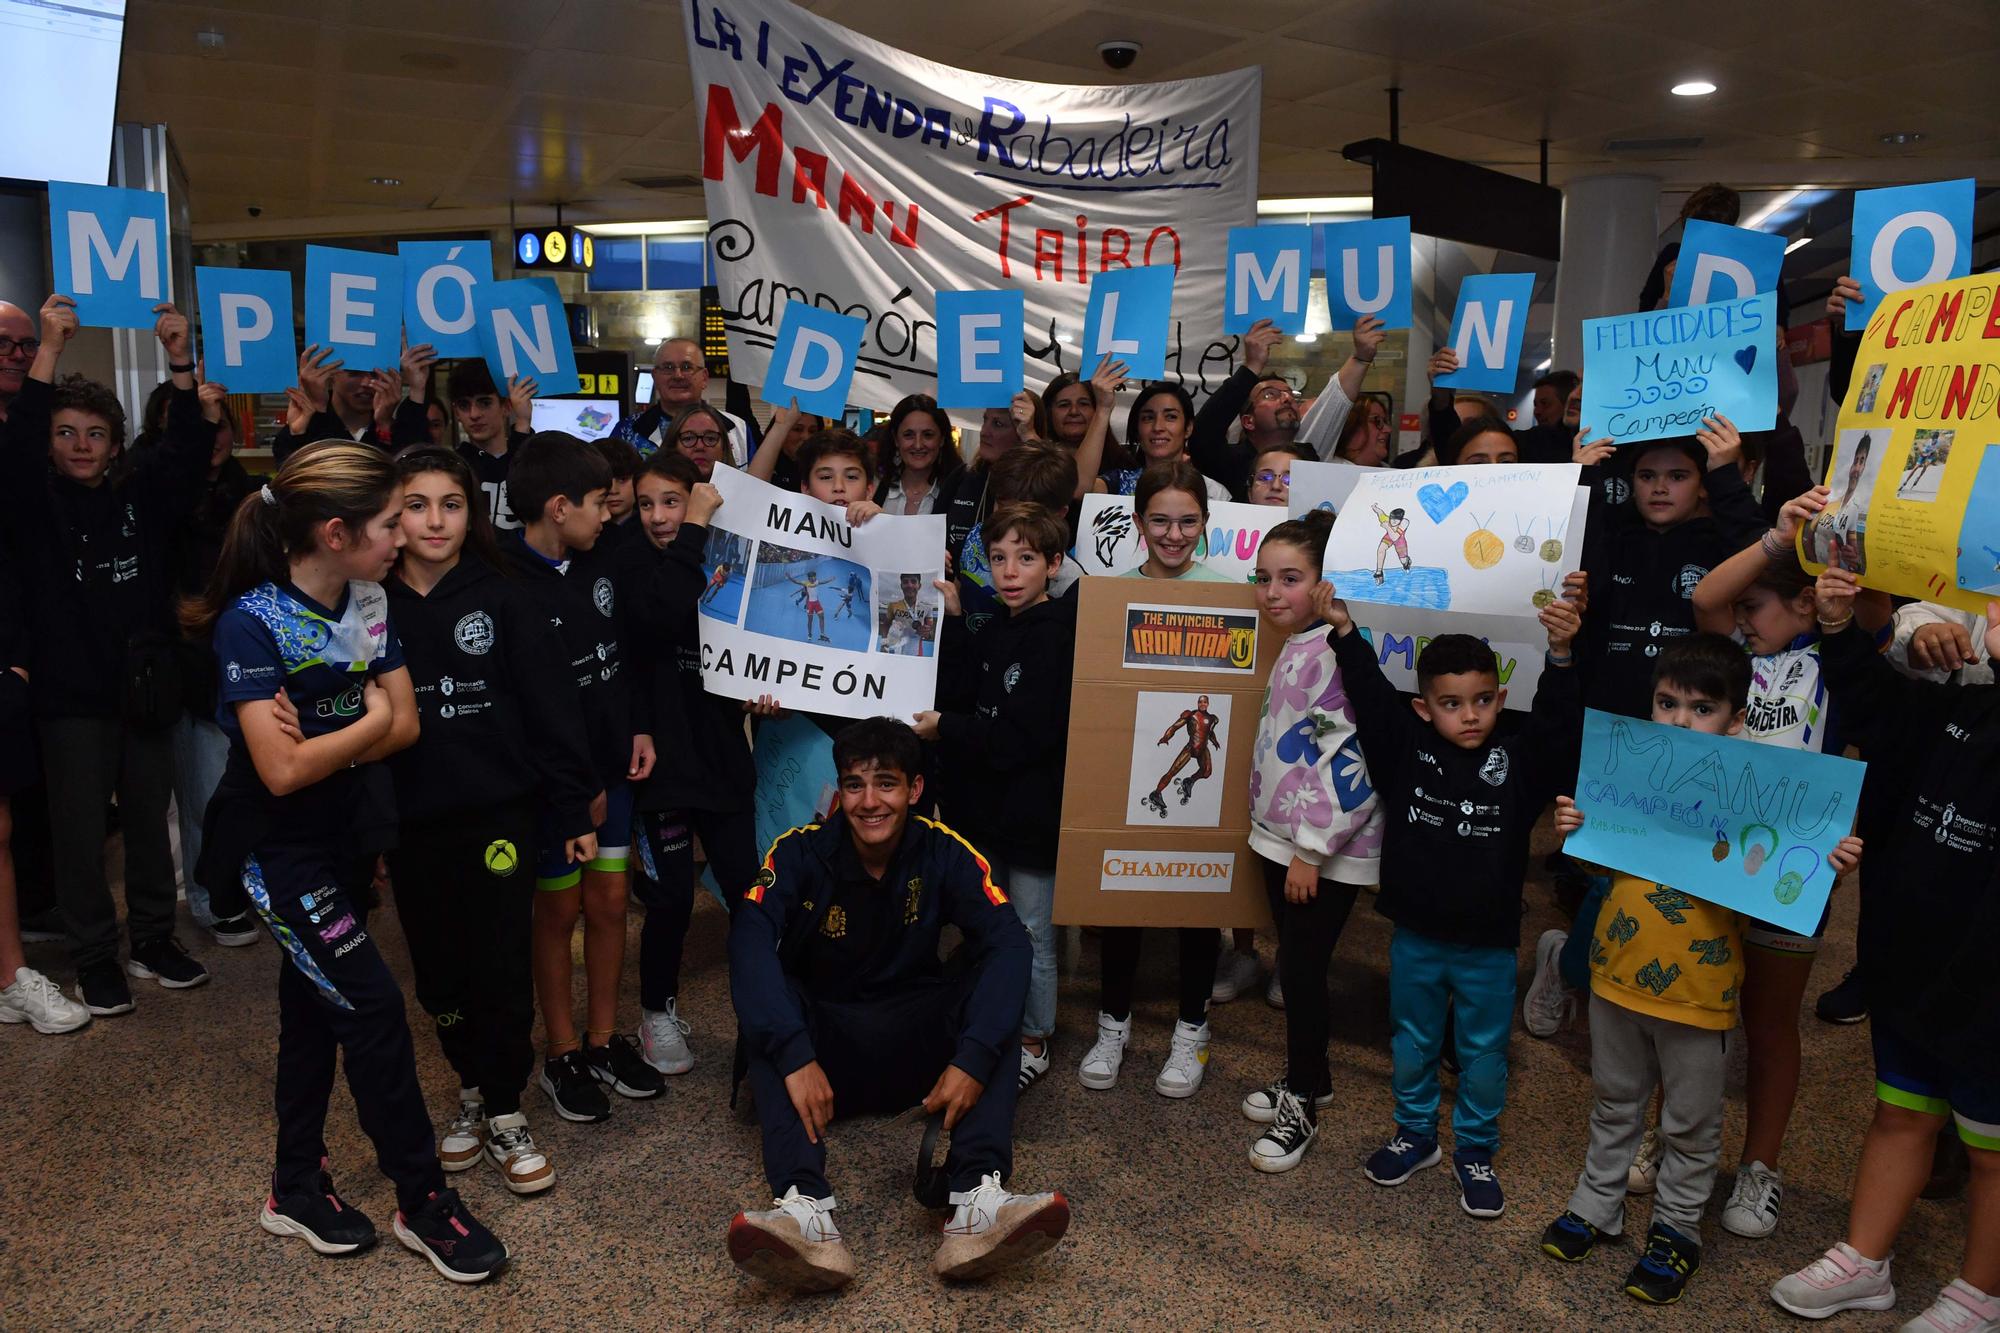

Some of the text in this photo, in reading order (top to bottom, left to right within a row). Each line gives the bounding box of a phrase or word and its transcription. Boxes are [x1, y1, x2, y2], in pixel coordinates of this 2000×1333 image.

[956, 116, 978, 147] del
[977, 95, 1233, 181] Rabadeira
[702, 83, 920, 250] MANU
[1596, 299, 1762, 351] FELICIDADES
[1885, 363, 2000, 421] MUND
[1608, 402, 1717, 438] Campeón
[766, 503, 853, 548] MANU
[1132, 628, 1183, 656] IRON
[1184, 632, 1233, 658] MAN
[1143, 612, 1225, 629] THE INVINCIBLE
[702, 643, 887, 700] CAMPEÓN
[1584, 779, 1729, 834] CAMPEÓN
[1604, 719, 1843, 841] MANU
[1103, 858, 1231, 879] CHAMPION
